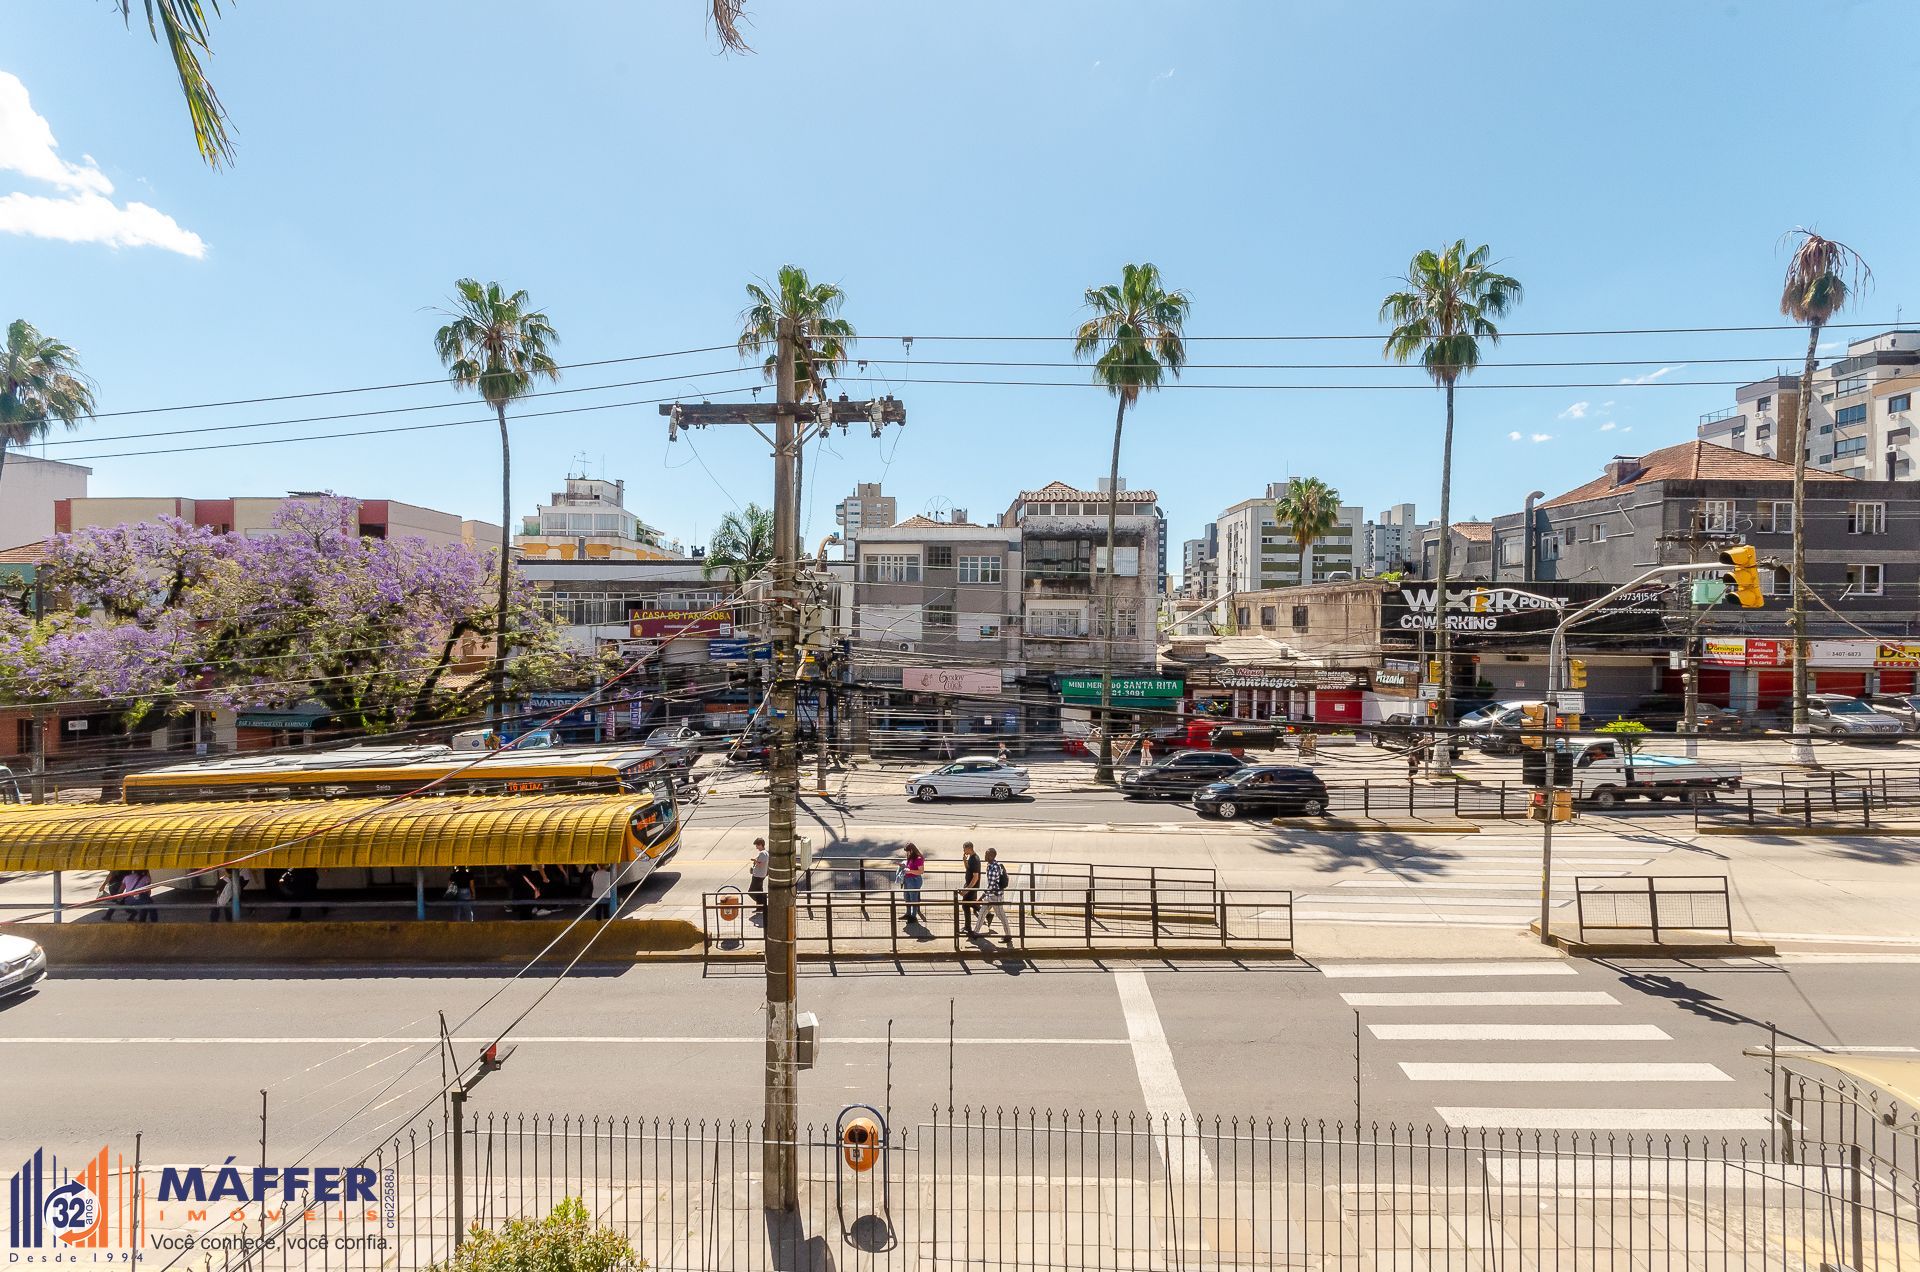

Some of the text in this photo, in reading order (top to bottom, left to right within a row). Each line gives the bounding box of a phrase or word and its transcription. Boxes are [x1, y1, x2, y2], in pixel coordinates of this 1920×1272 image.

[633, 611, 640, 620] A
[642, 611, 665, 620] CASA
[668, 611, 680, 620] DO
[1400, 615, 1497, 630] COWRKING
[1706, 643, 1743, 652] Domingos
[1376, 671, 1405, 685] Pizzaria
[1068, 681, 1178, 690] MINI MERDO SANTA RITA
